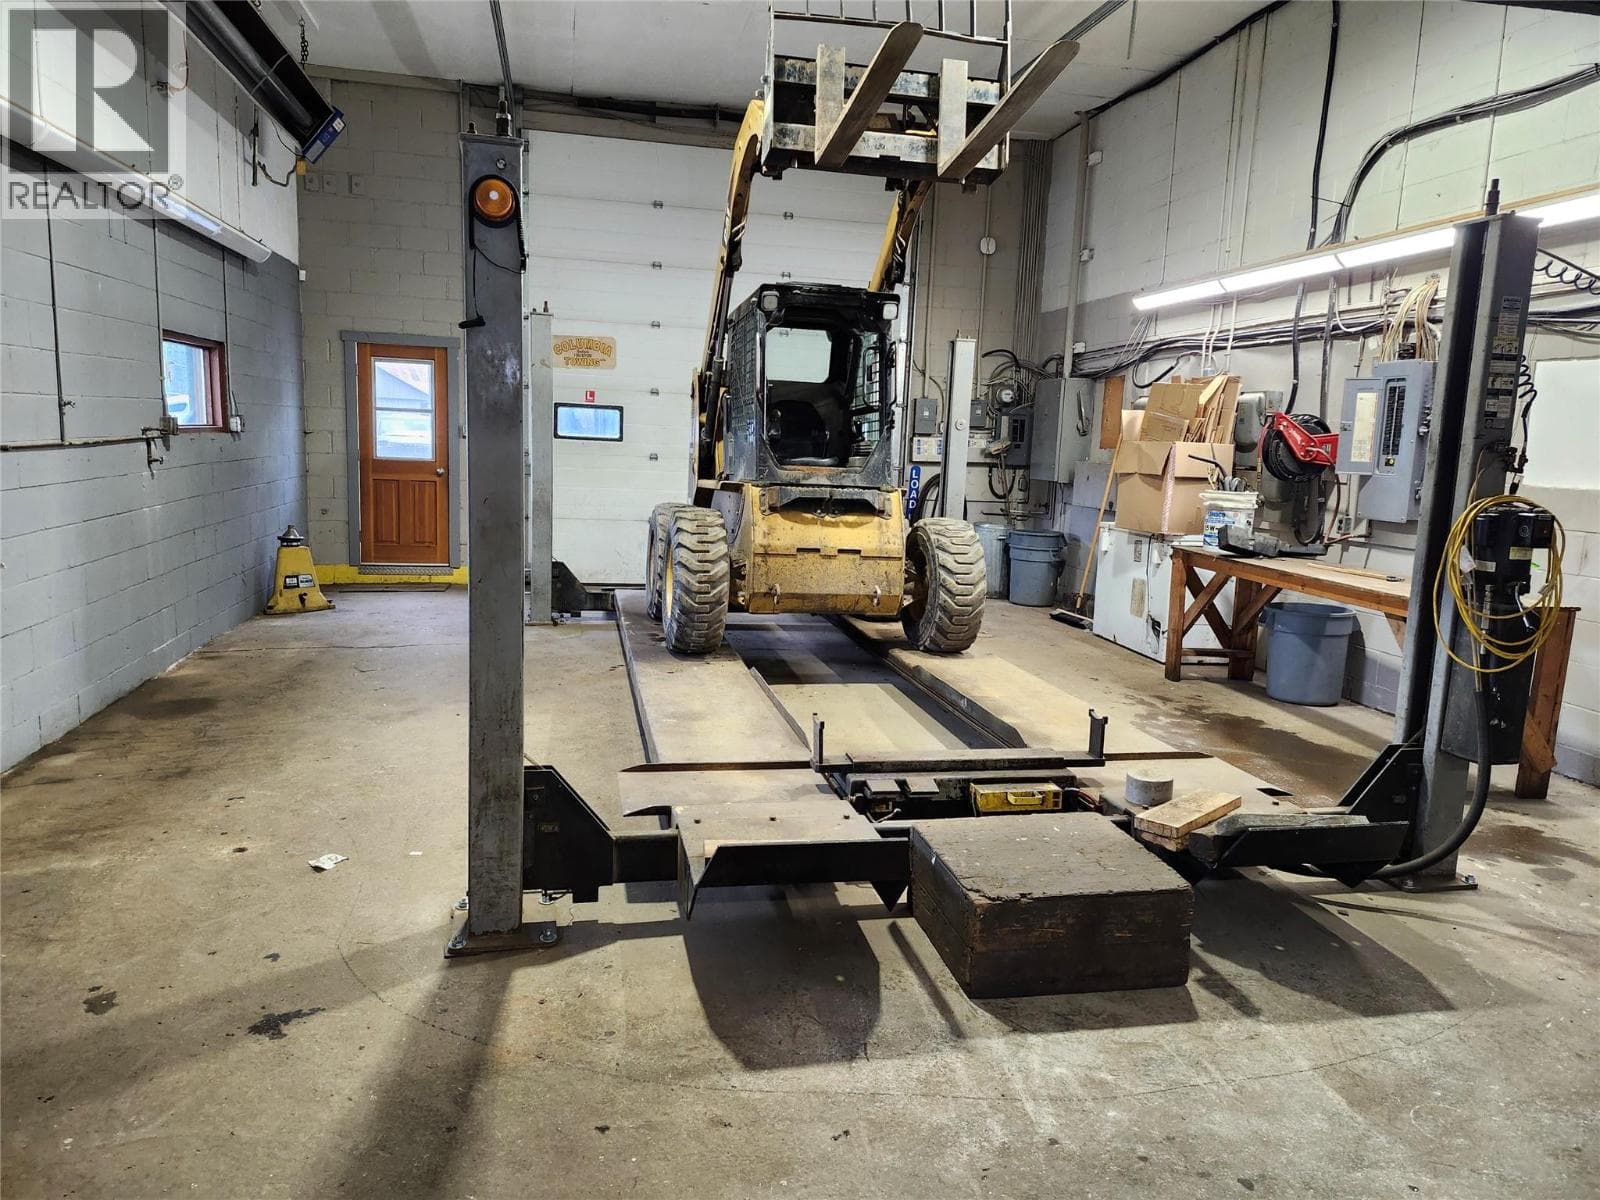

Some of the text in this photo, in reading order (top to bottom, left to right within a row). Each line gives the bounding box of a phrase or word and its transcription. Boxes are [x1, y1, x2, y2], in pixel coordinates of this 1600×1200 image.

[553, 337, 612, 358] COLUMBIA
[564, 356, 601, 367] TOWING
[909, 469, 919, 509] LOAD
